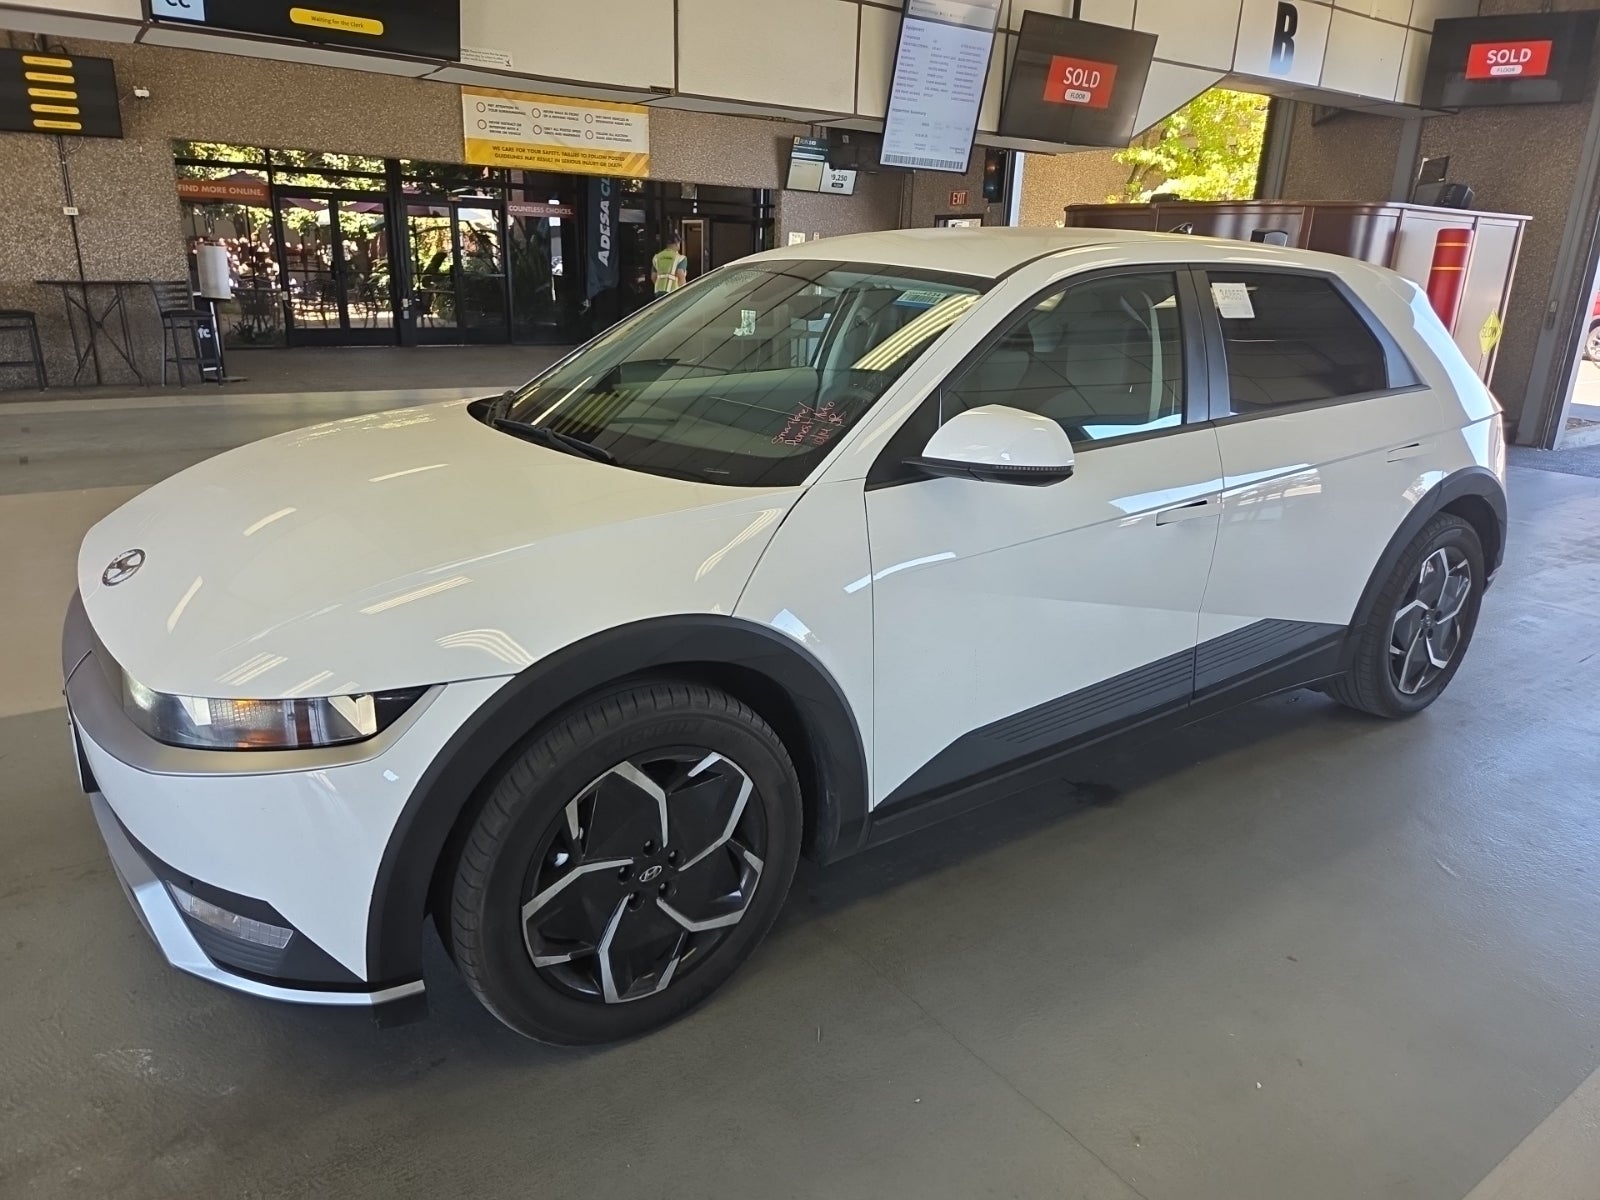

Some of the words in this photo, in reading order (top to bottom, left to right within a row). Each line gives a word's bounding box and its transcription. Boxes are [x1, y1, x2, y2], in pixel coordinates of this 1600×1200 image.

[311, 15, 331, 24] Waiting
[1269, 2, 1298, 75] B
[1486, 48, 1532, 64] SOLD
[1063, 67, 1100, 88] SOLD
[1070, 92, 1086, 100] FLOOR
[177, 184, 199, 192] FIND
[201, 185, 227, 194] MORE
[229, 187, 264, 196] ONLINE.
[952, 192, 966, 205] EXIT
[508, 205, 544, 214] COUNTLESS
[546, 207, 574, 215] CHOICES.
[598, 200, 611, 267] ADESA
